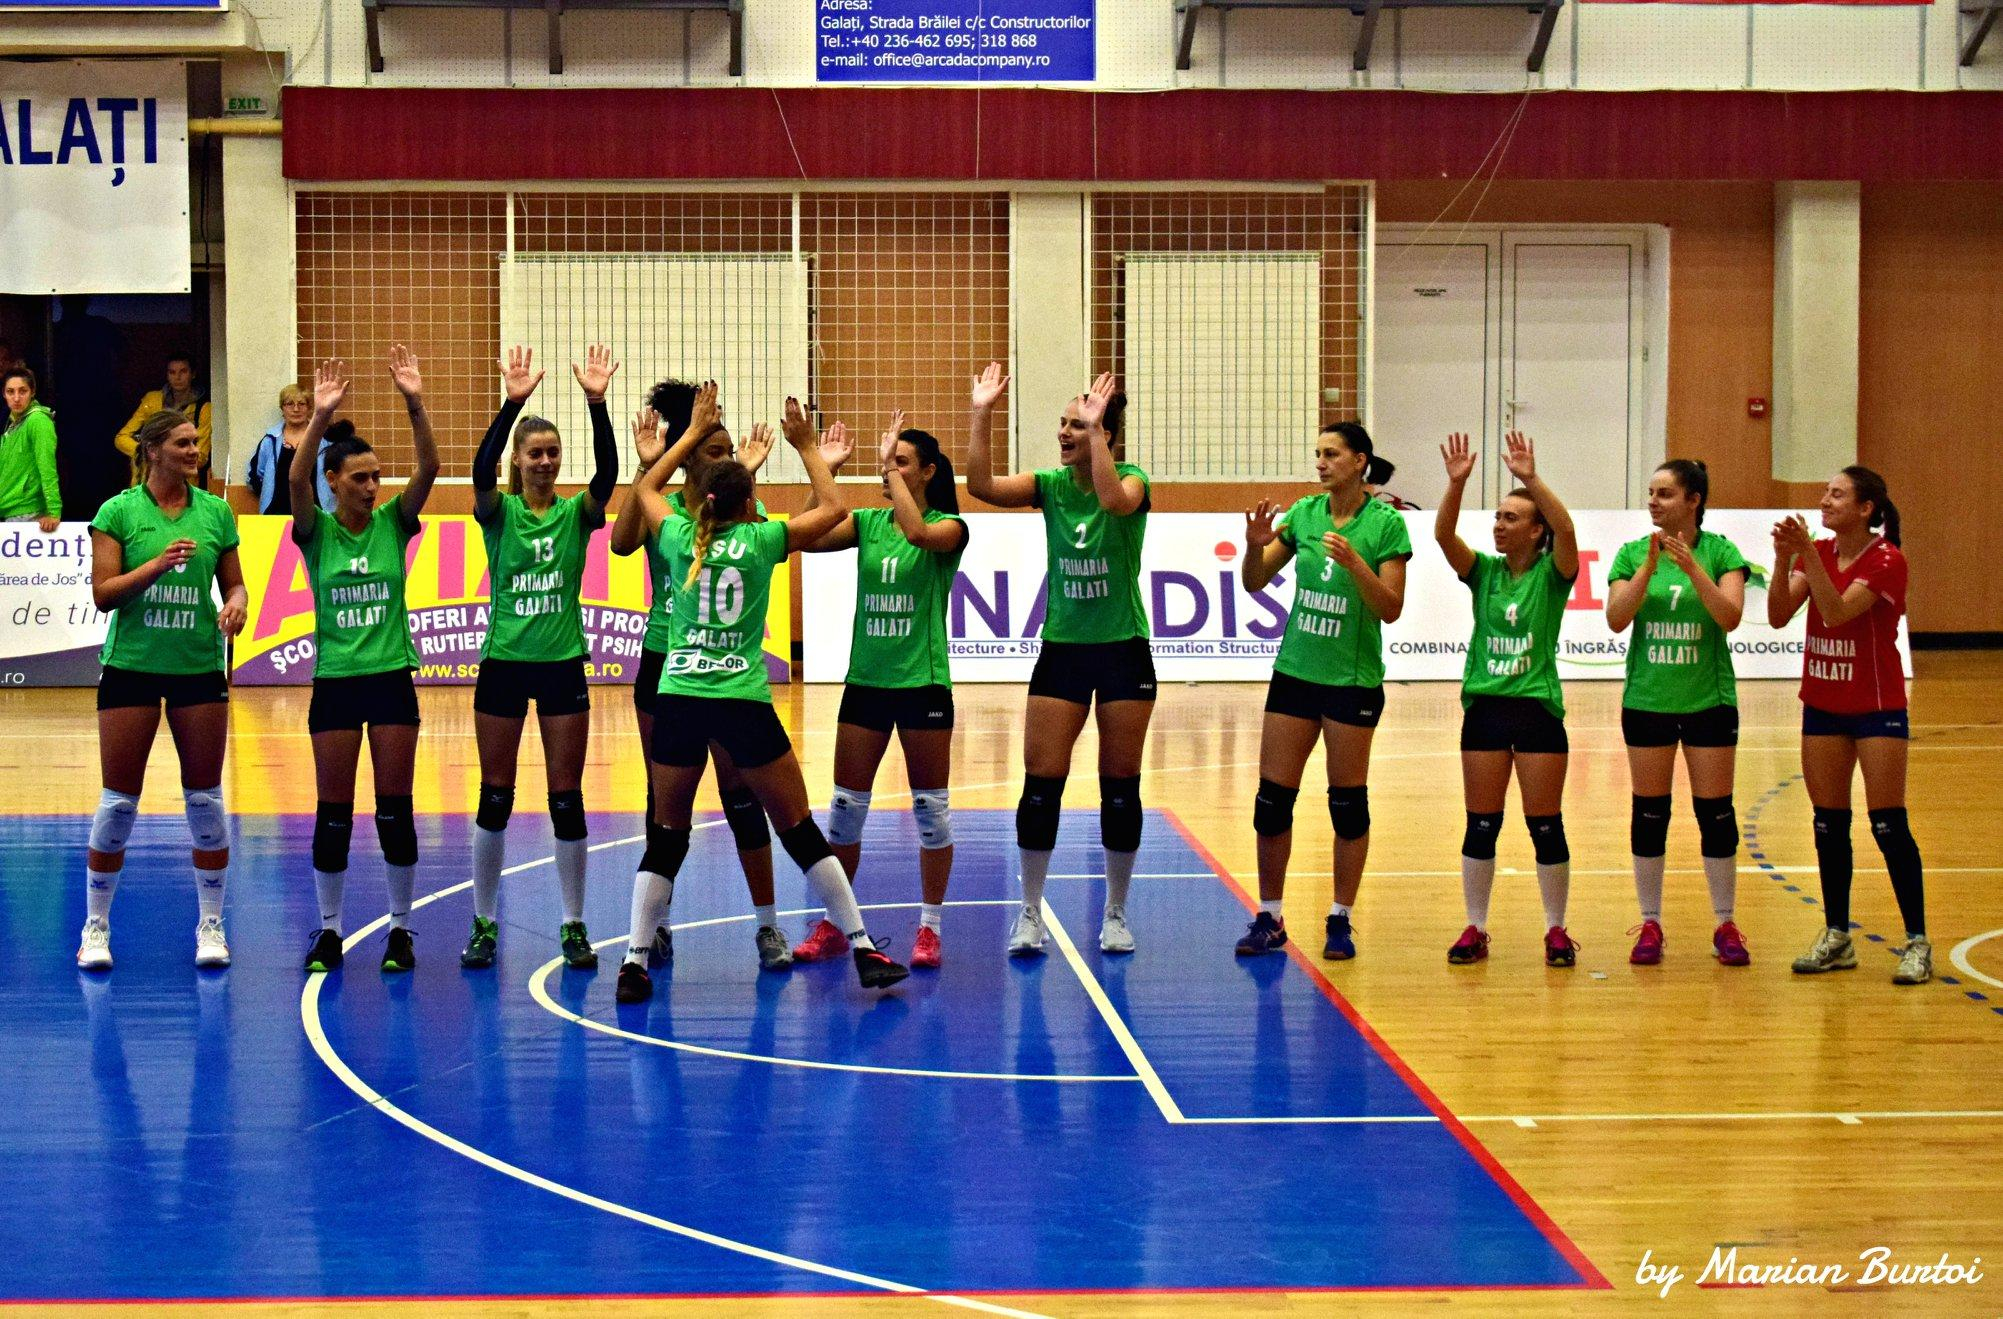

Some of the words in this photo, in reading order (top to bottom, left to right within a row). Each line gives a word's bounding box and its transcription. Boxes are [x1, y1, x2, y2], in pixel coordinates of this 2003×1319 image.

[821, 16, 864, 32] Galați,
[869, 16, 915, 29] Strada
[919, 16, 961, 29] Brăilei
[965, 16, 986, 31] c/c
[990, 16, 1091, 29] Constructorilor
[821, 35, 879, 48] Tel.:+40
[884, 35, 940, 48] 236-462
[945, 35, 976, 50] 695;
[981, 35, 1007, 48] 318
[1011, 35, 1037, 48] 868
[821, 54, 868, 66] e-mail:
[873, 53, 1050, 69] office@arcadacompany.ro
[229, 97, 260, 110] EXIT
[1074, 522, 1087, 549] 2
[1, 531, 93, 567] denț
[531, 537, 554, 563] 13
[881, 556, 898, 584] 11
[1059, 557, 1109, 577] PRIMARIA
[1320, 556, 1334, 582] 3
[31, 572, 49, 585] de
[511, 571, 564, 593] PRIMARIA
[144, 585, 199, 606] PRIMARIA
[331, 581, 390, 606] PRIMARIA
[694, 566, 744, 625] 10
[1063, 580, 1109, 600] GALATI
[1669, 585, 1683, 611] 7
[864, 593, 914, 612] PRIMARIA
[1298, 588, 1348, 615] PRIMARIA
[12, 601, 51, 625] de
[144, 609, 195, 630] GALATI
[336, 605, 387, 629] GALATI
[473, 606, 491, 626] A
[1504, 603, 1518, 627] 4
[866, 617, 911, 637] GALATI
[1297, 612, 1341, 639] GALATI
[1646, 621, 1702, 641] PRIMARIA
[686, 628, 744, 649] GALATI
[1390, 642, 1471, 654] COMBINA
[1806, 635, 1856, 658] PRIMARIA
[1648, 645, 1699, 665] GALATI
[1808, 659, 1853, 682] GALATI
